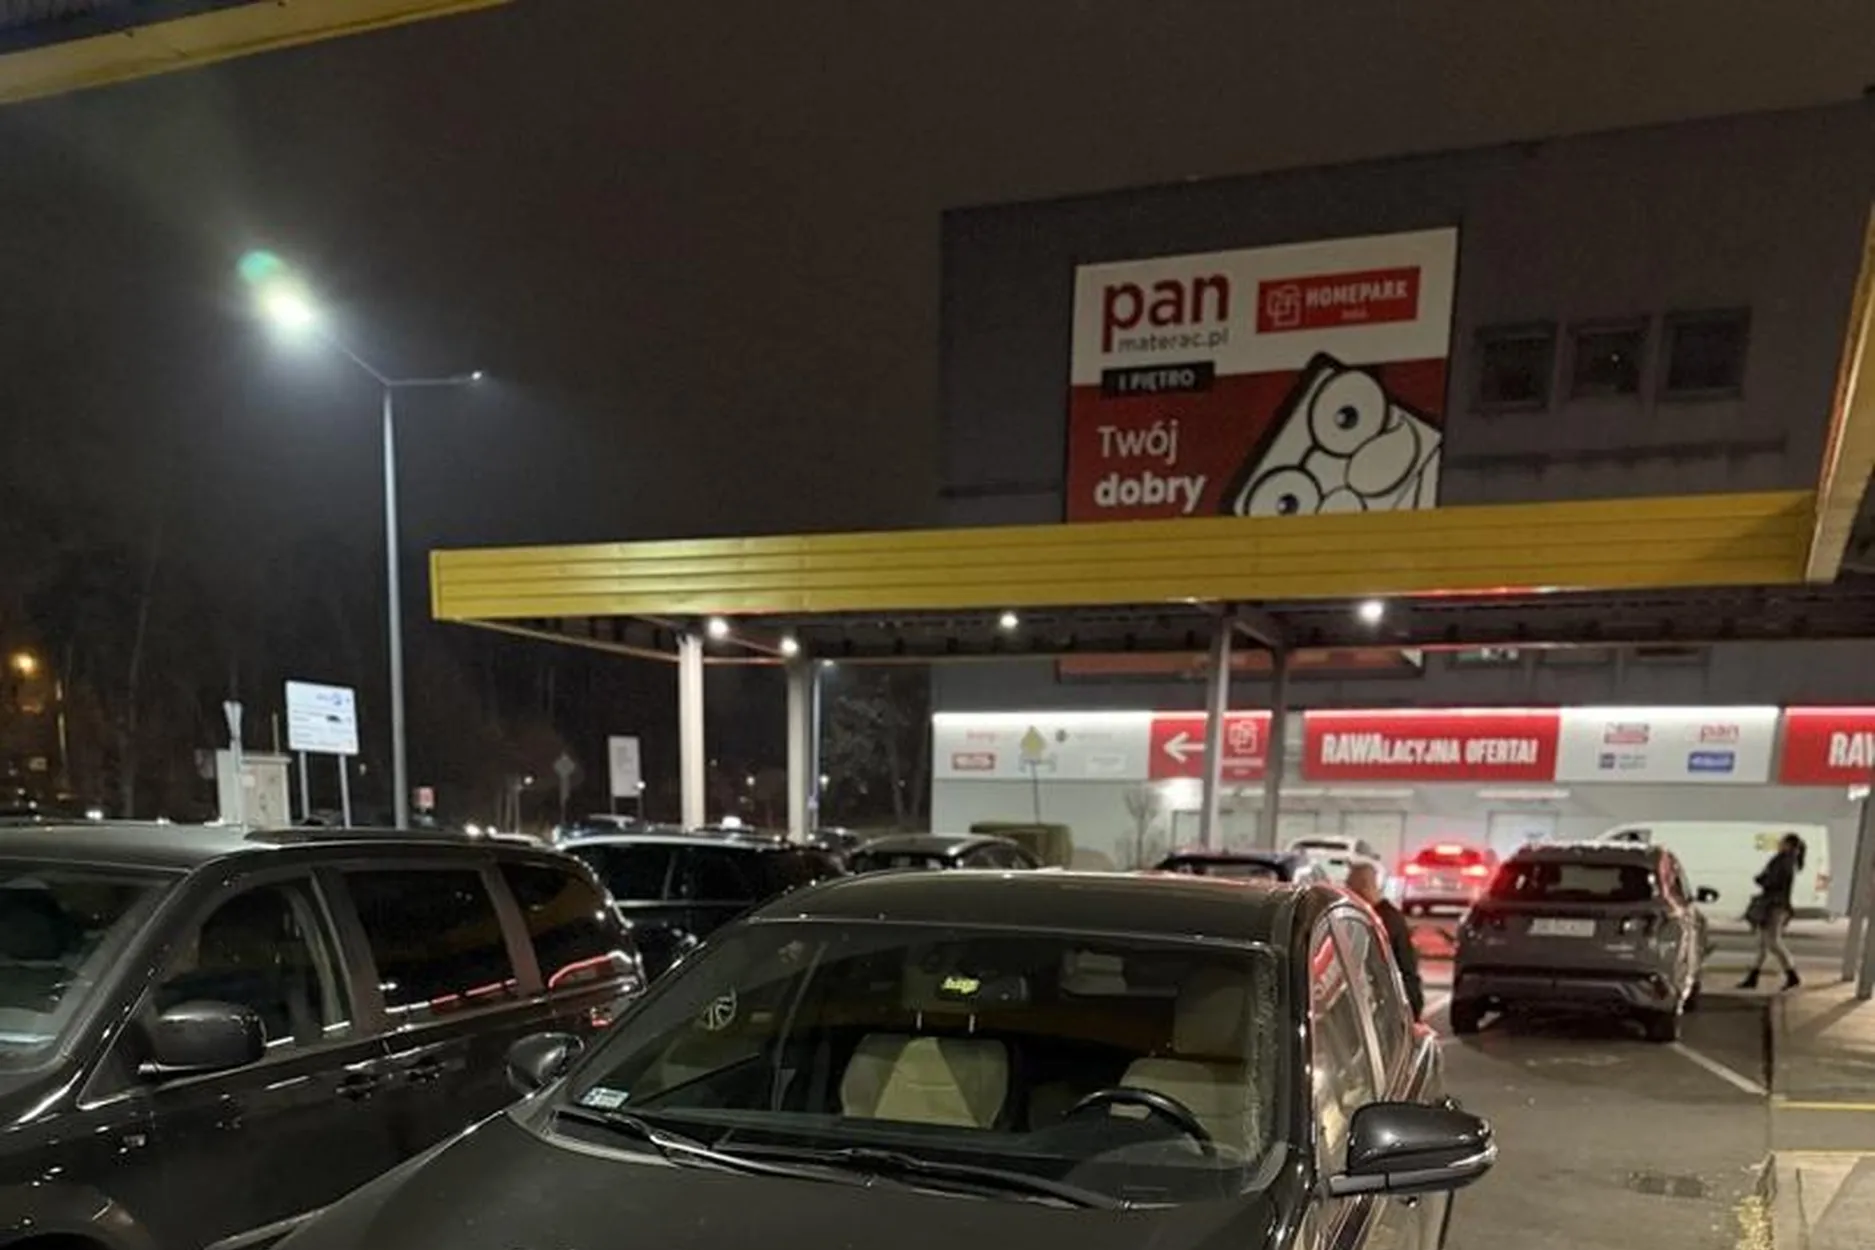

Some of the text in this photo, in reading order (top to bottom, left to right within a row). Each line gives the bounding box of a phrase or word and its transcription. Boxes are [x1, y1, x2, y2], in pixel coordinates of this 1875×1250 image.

[1305, 279, 1408, 308] HOMEPARK
[1102, 272, 1230, 353] pan
[1118, 327, 1230, 353] materac.pl
[1097, 420, 1179, 464] Twój
[1094, 469, 1206, 513] dobry
[1465, 738, 1539, 764] OFERTA!
